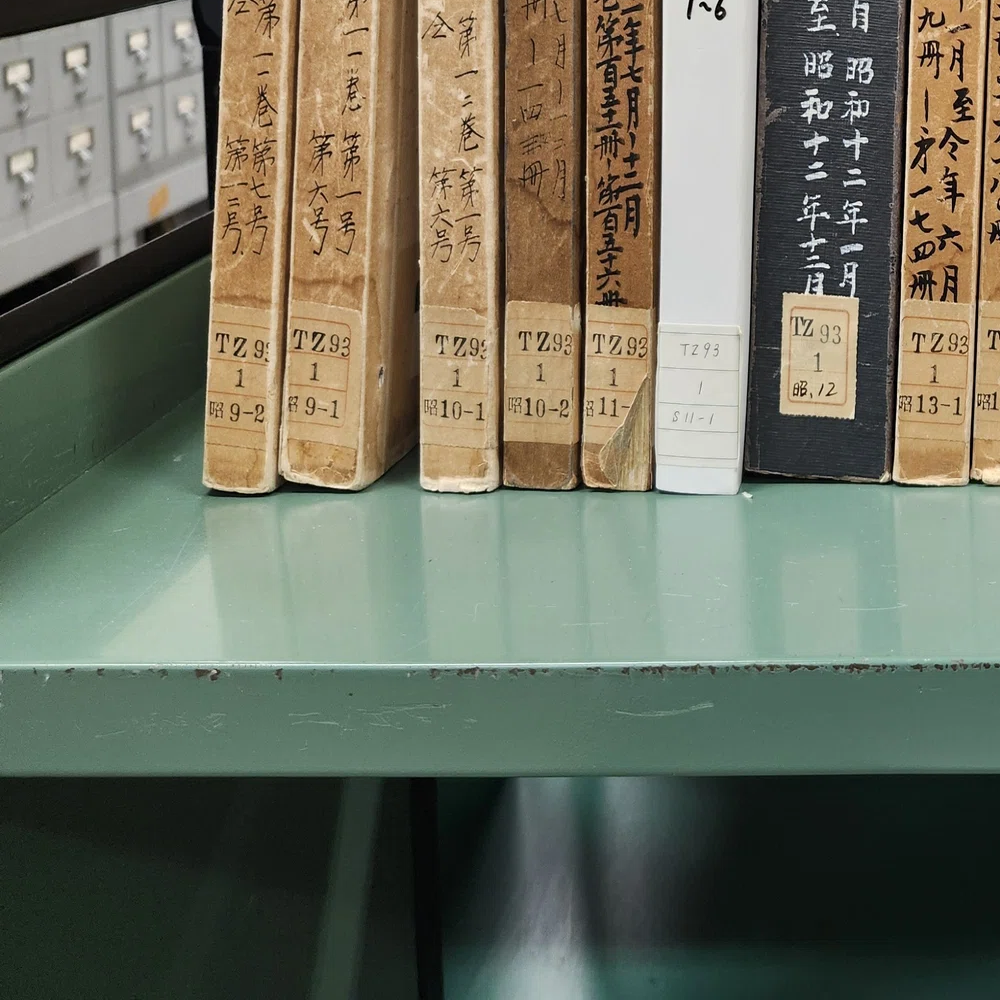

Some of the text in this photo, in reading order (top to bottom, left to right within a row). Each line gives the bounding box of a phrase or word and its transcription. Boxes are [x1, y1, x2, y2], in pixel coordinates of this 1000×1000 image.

[813, 352, 823, 372] 1
[235, 368, 245, 388] 1
[310, 363, 320, 381] 1
[452, 369, 462, 387] 1
[536, 363, 546, 382] 1
[609, 368, 619, 386] 1
[929, 364, 939, 384] 1
